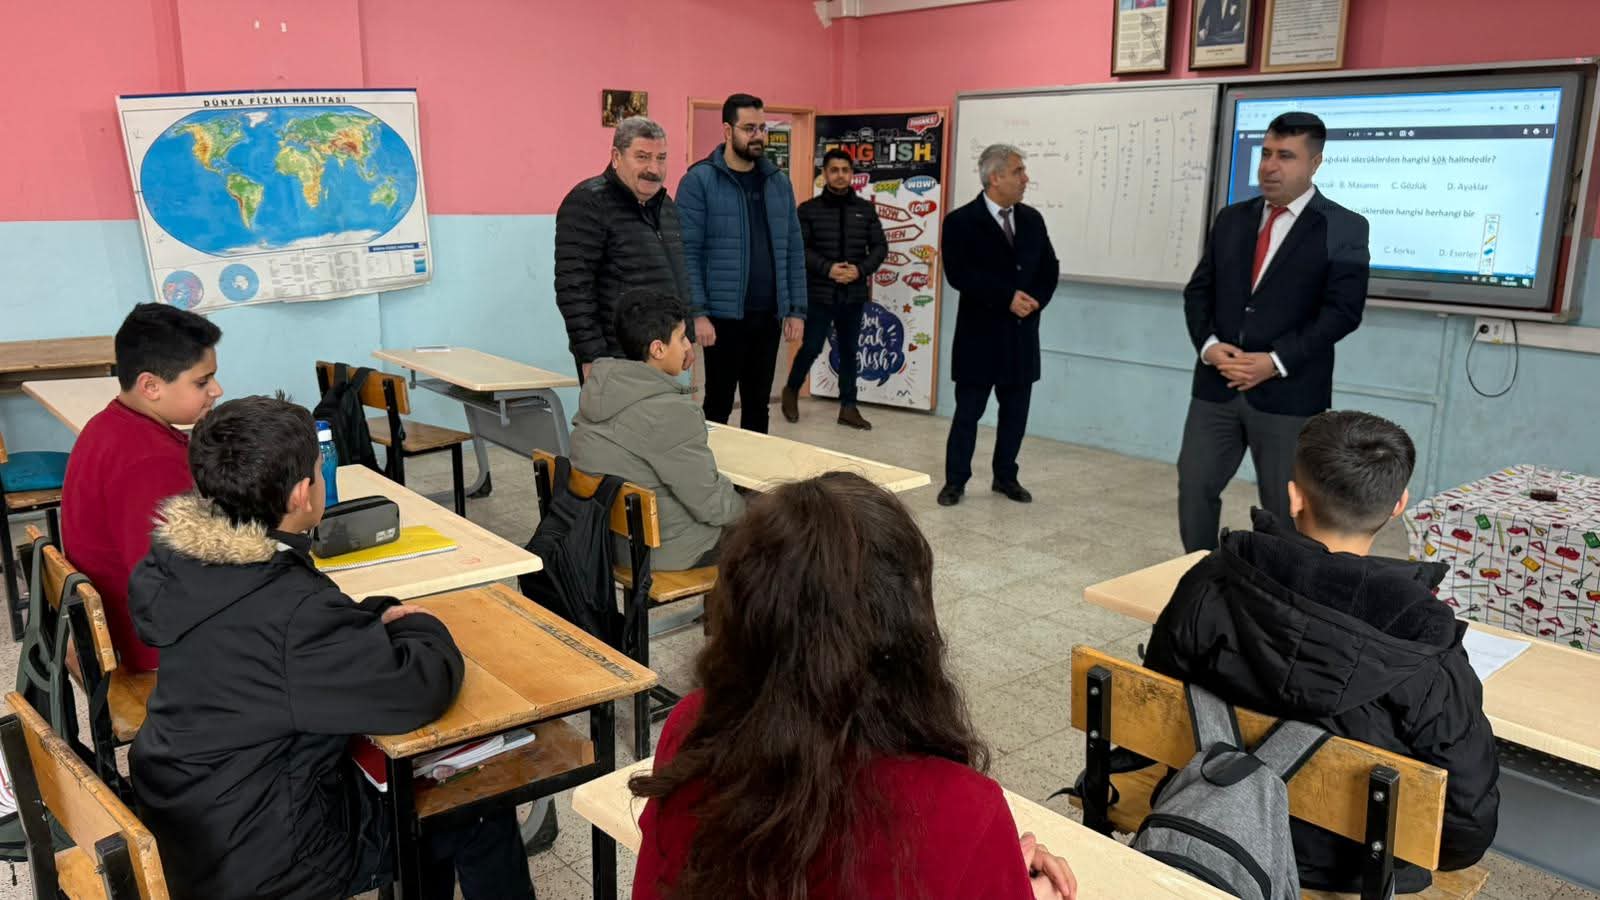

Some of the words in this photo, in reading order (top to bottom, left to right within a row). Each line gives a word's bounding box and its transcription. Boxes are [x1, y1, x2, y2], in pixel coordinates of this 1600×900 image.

[203, 98, 244, 107] DÜNYA
[250, 95, 288, 105] FİZİKİ
[292, 95, 346, 104] HARİTASI
[1402, 155, 1430, 165] hangisi
[1432, 155, 1447, 164] kök
[1448, 155, 1497, 164] halindedir?
[1391, 182, 1400, 191] C.
[1447, 183, 1456, 191] D.
[1457, 183, 1489, 193] Ayaklar
[878, 206, 899, 219] HOW
[1396, 207, 1424, 217] hangisi
[1425, 208, 1462, 218] herhangi
[1463, 208, 1476, 217] bir
[887, 229, 906, 240] HEN
[1439, 248, 1448, 257] D.
